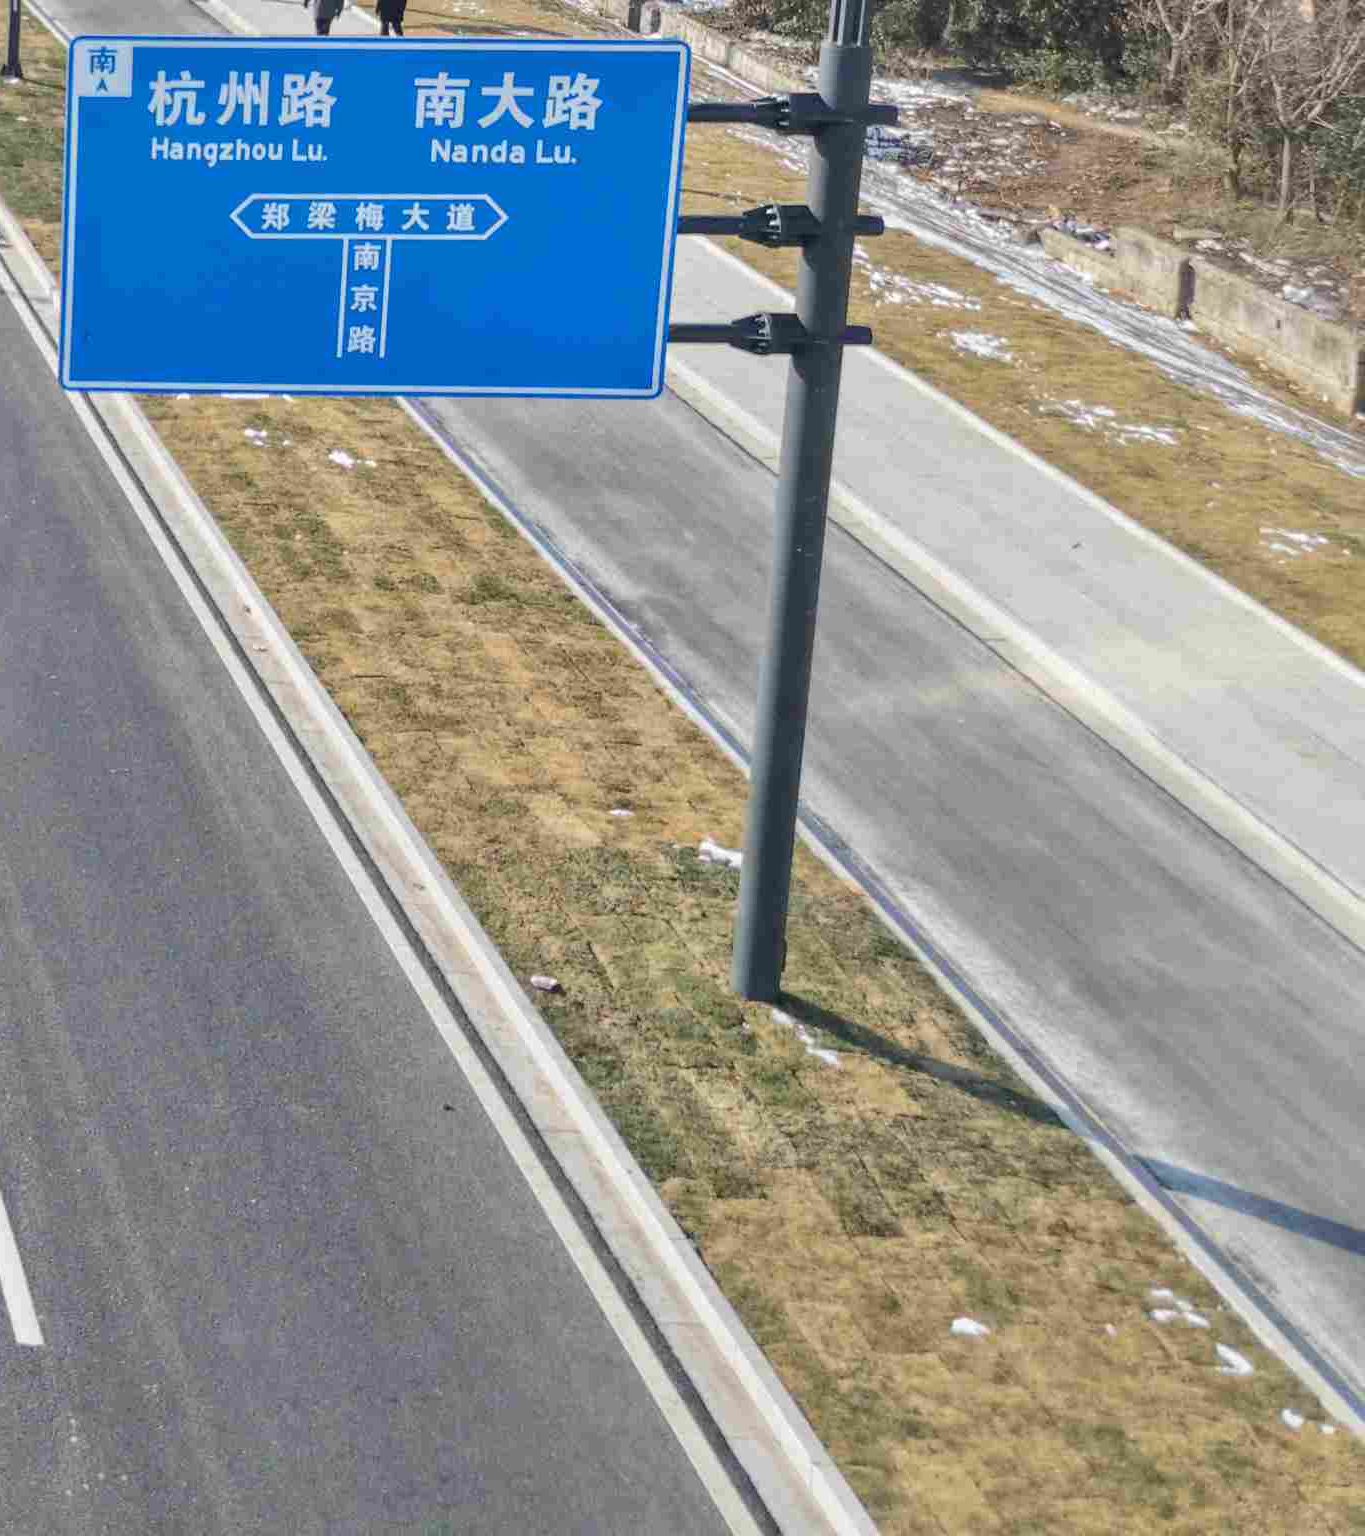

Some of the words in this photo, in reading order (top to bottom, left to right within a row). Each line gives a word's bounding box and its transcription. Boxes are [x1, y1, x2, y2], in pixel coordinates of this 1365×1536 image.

[89, 46, 118, 74] 南
[148, 70, 337, 128] 杭州路
[414, 71, 603, 130] 南大路
[151, 137, 283, 168] Hangzhou
[292, 138, 327, 161] Lu.
[431, 139, 526, 164] Nanda
[536, 140, 577, 164] Lu.
[261, 201, 475, 231] 郑梁梅大道
[348, 242, 382, 353] 南京路
